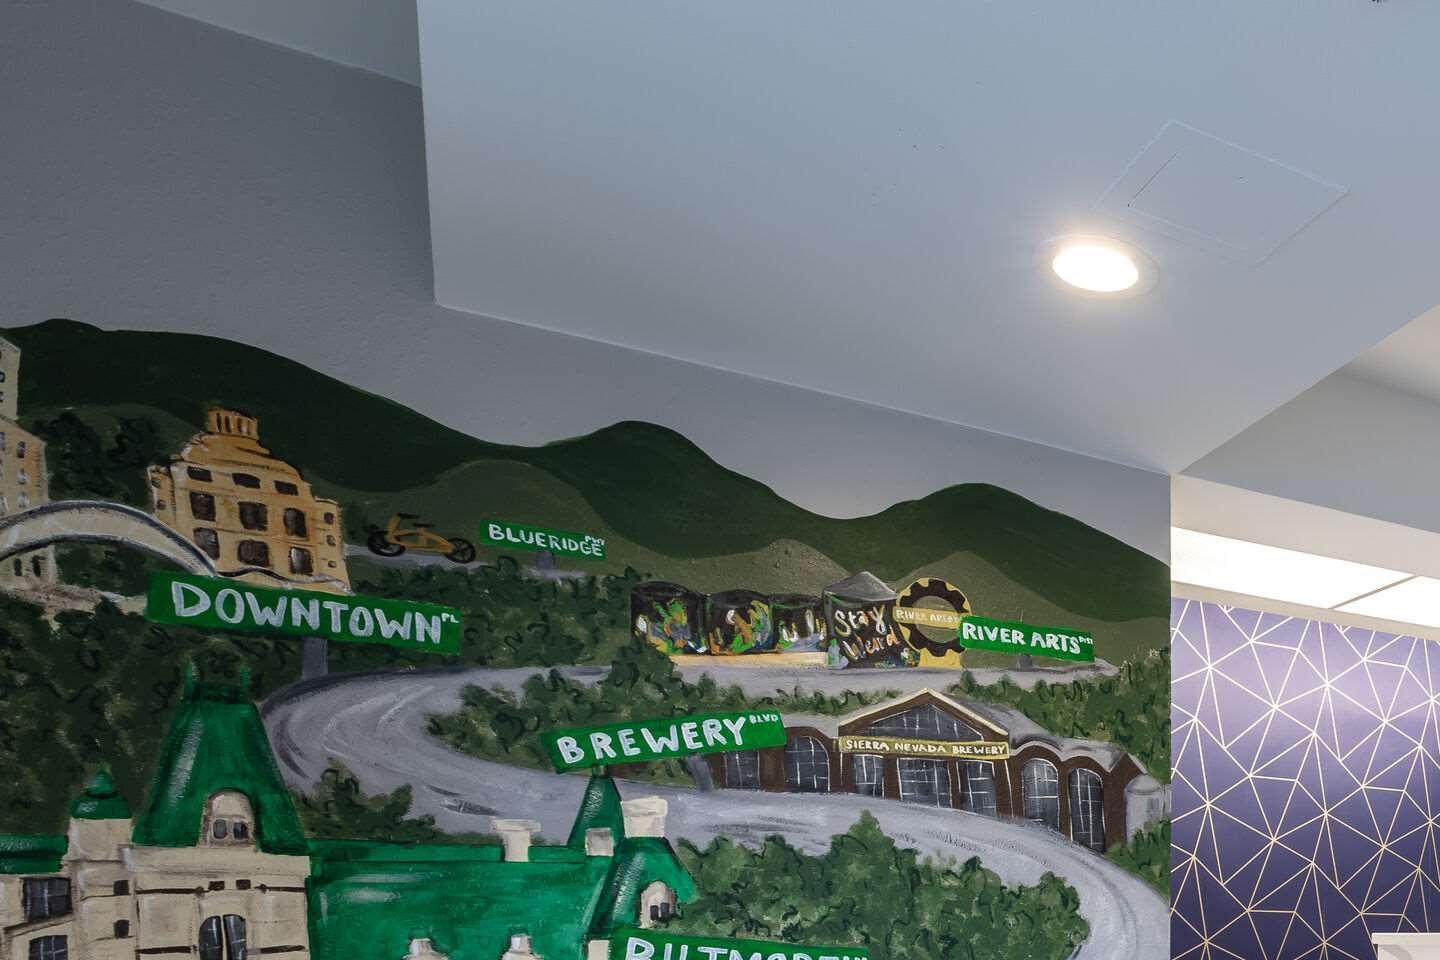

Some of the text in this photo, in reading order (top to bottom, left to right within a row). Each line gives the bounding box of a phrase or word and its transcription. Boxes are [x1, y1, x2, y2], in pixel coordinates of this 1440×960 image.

[488, 523, 603, 556] BLUERIDGE
[171, 581, 460, 644] DOWNTOWN PL
[835, 605, 886, 637] Stay
[962, 622, 1027, 645] RIVER
[1031, 631, 1080, 655] ARTS
[556, 714, 779, 764] BREWERY BLVD
[846, 740, 1005, 755] SIERRA NEVADA BREWERY
